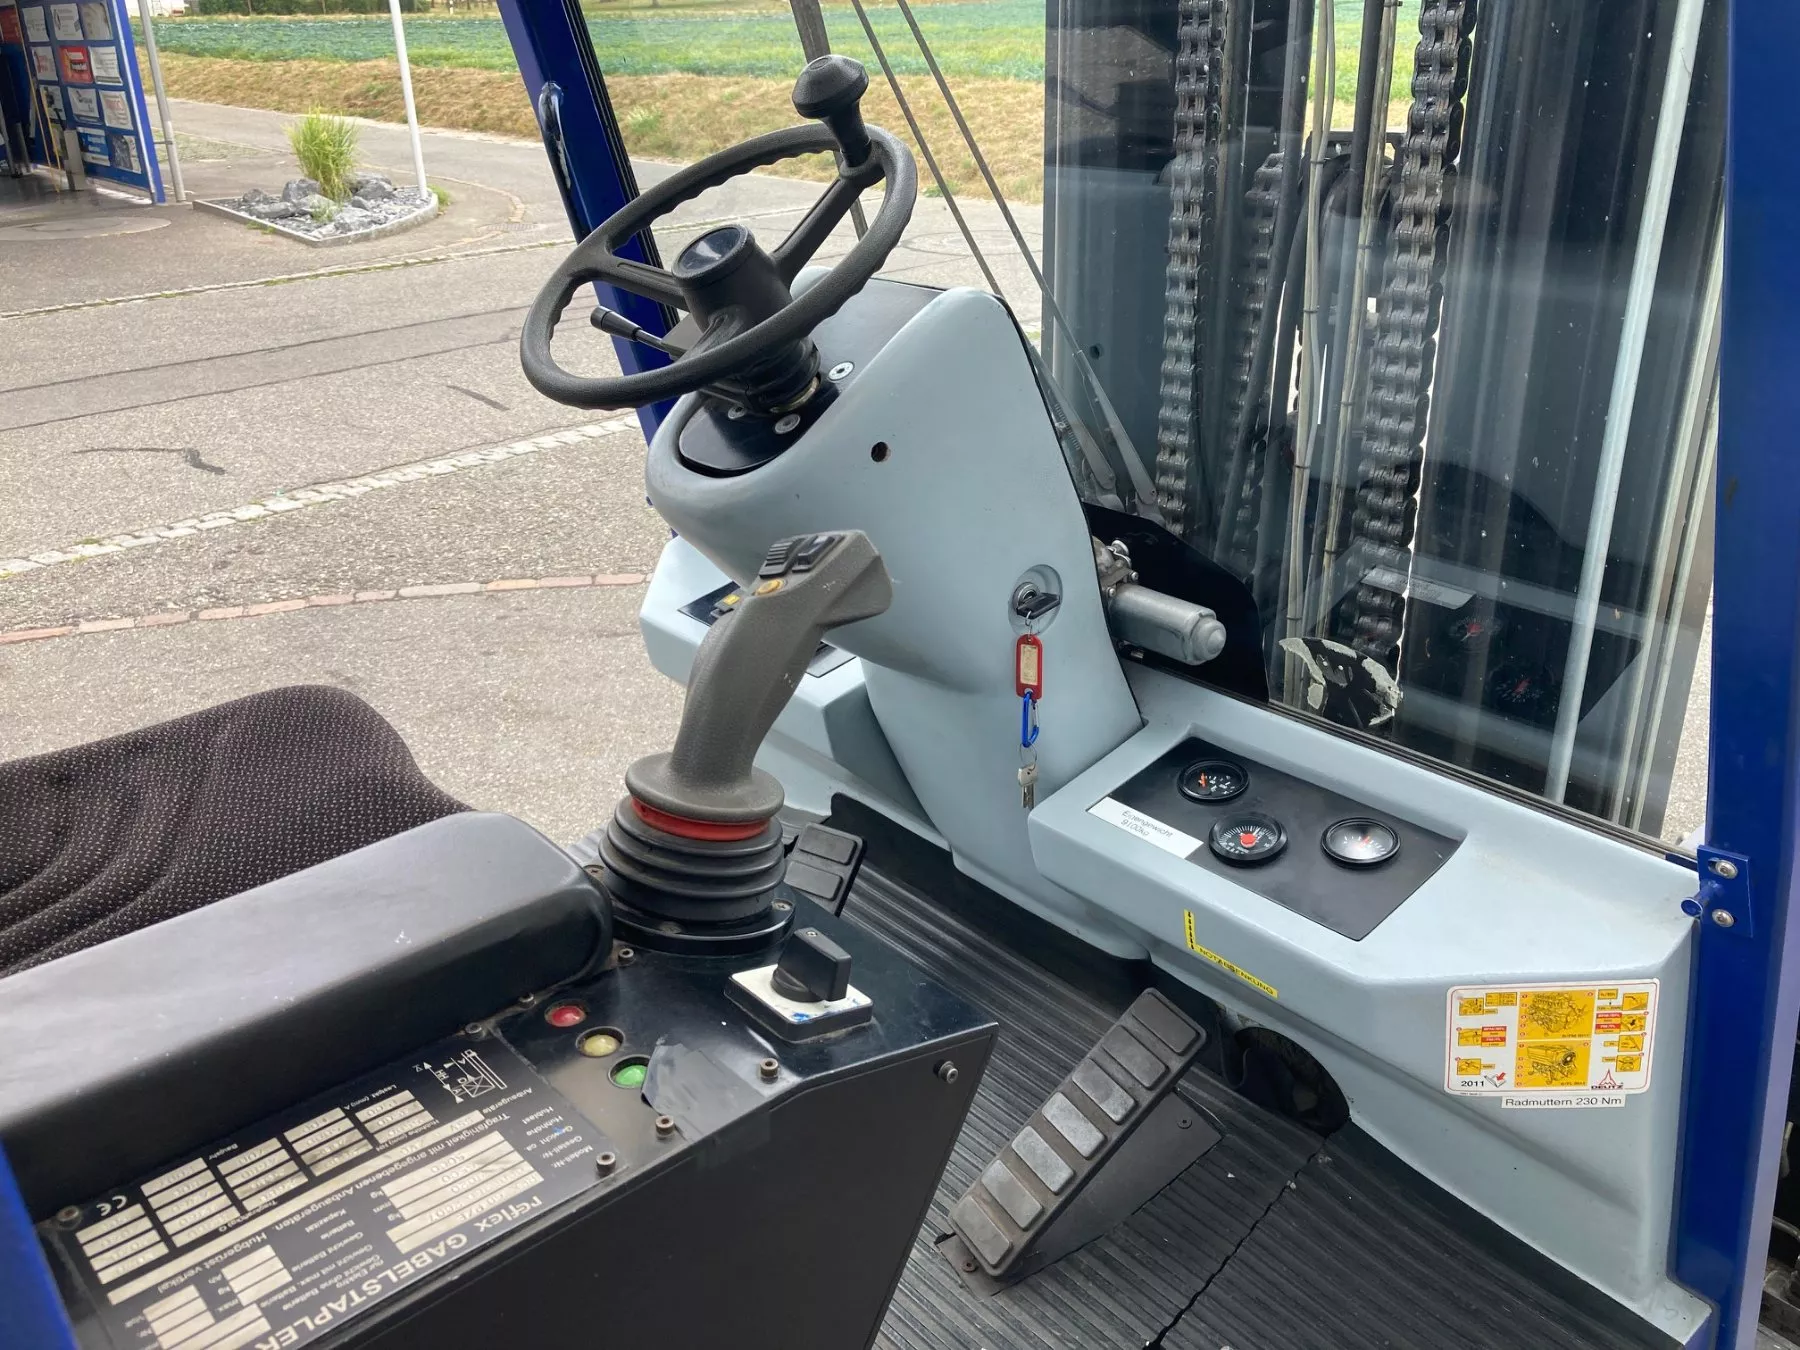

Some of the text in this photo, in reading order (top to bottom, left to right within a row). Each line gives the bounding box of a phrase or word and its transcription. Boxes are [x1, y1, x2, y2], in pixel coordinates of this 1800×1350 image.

[1199, 947, 1275, 996] NOTABSENKUNG
[1461, 1080, 1485, 1088] 2011
[1505, 1096, 1623, 1107] Radmuttern 230 Nm
[522, 1106, 554, 1124] Hublast
[445, 1113, 510, 1147] Tragfähigkeit
[428, 1143, 445, 1155] mit
[355, 1152, 427, 1189] angegebenen
[370, 1190, 384, 1199] kg
[320, 1220, 355, 1239] Batterie
[203, 1232, 267, 1269] Hubgerüst
[158, 1266, 203, 1293] vertikal
[255, 1196, 542, 1350] reflex GABELSTAPLER
